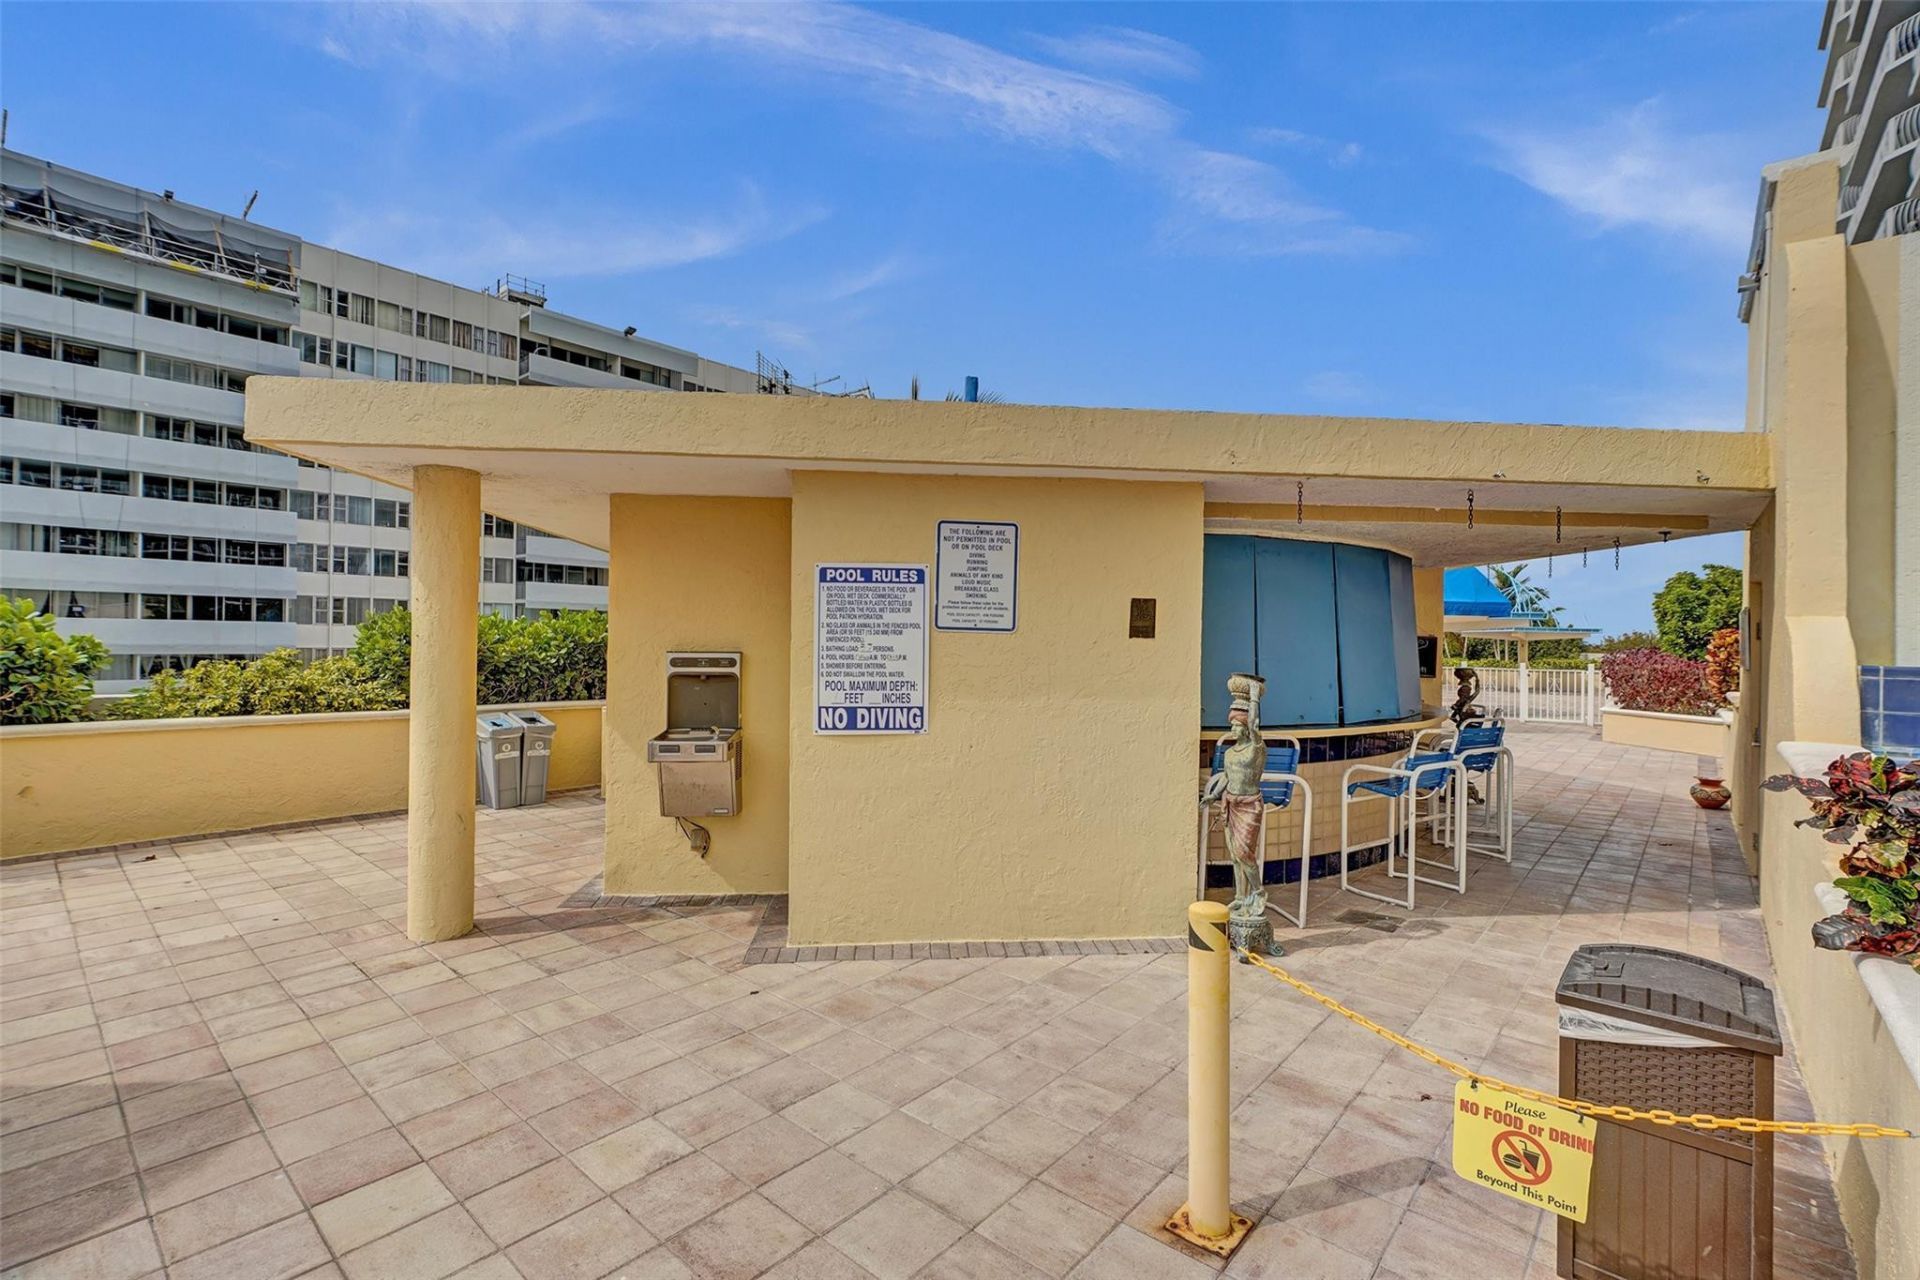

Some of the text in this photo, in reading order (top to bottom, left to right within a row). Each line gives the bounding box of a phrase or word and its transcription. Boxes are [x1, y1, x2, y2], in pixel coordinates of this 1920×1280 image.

[827, 569, 917, 581] POOL RULES
[825, 681, 918, 691] POOL MAXIMUM DEPTH:
[845, 693, 911, 703] FEET INCHES
[821, 708, 921, 728] NO DIVING
[1460, 1099, 1479, 1115] NO
[1484, 1107, 1523, 1130] FOOD
[1529, 1124, 1544, 1136] or
[1505, 1101, 1546, 1119] Please
[1477, 1170, 1577, 1213] Beyond This Point
